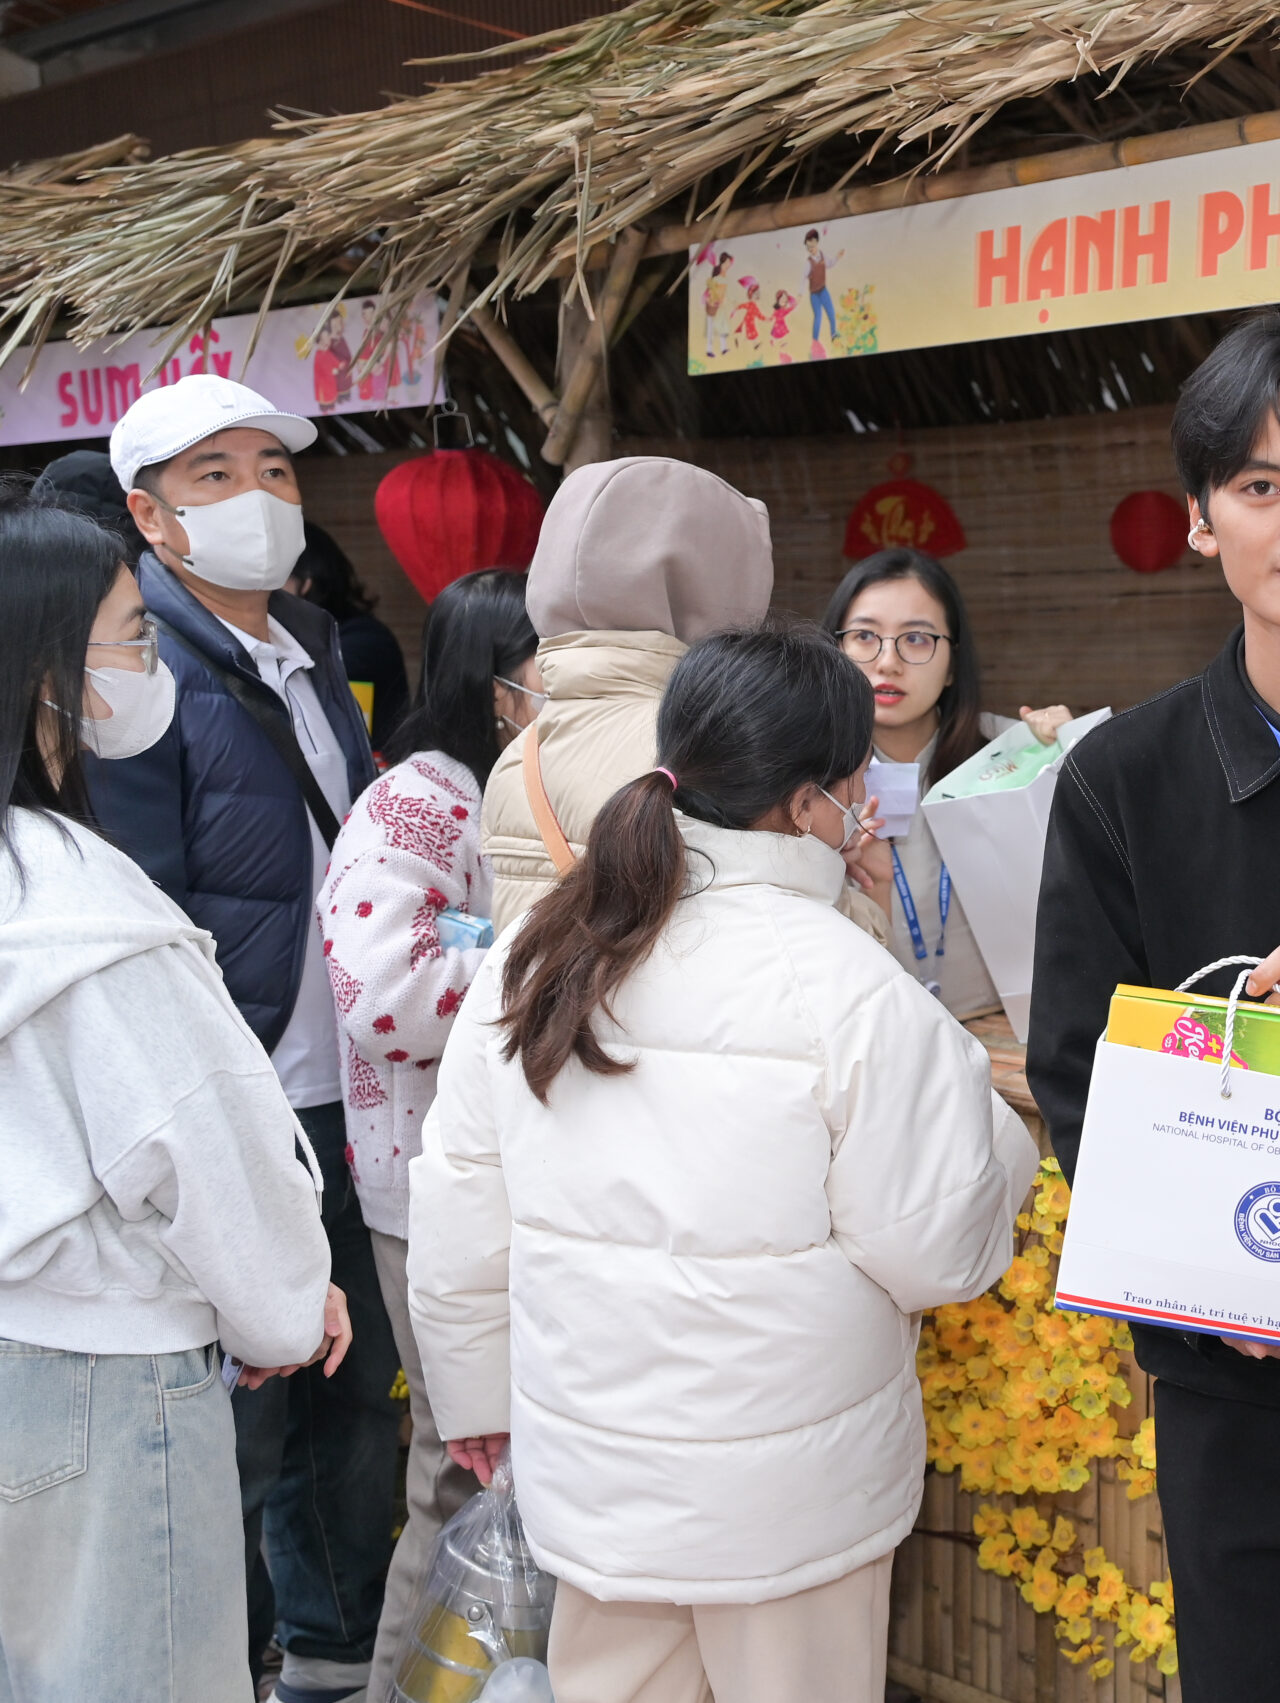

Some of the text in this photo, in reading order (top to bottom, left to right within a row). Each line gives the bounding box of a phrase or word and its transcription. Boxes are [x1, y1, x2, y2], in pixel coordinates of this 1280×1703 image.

[974, 200, 1170, 324] HẠNH
[1153, 1122, 1200, 1140] NATIONAL
[1202, 1132, 1248, 1150] HOSPITAL
[1251, 1141, 1265, 1152] OF
[1179, 1110, 1215, 1130] BỆNH
[1218, 1118, 1249, 1136] VIỆN
[1251, 1126, 1280, 1143] PHỤ
[1264, 1184, 1277, 1194] BỘ
[1123, 1291, 1152, 1305] Trao
[1156, 1298, 1187, 1312] nhân
[1191, 1302, 1206, 1317] ái,
[1210, 1308, 1225, 1319] trí
[1228, 1311, 1249, 1324] tuệ
